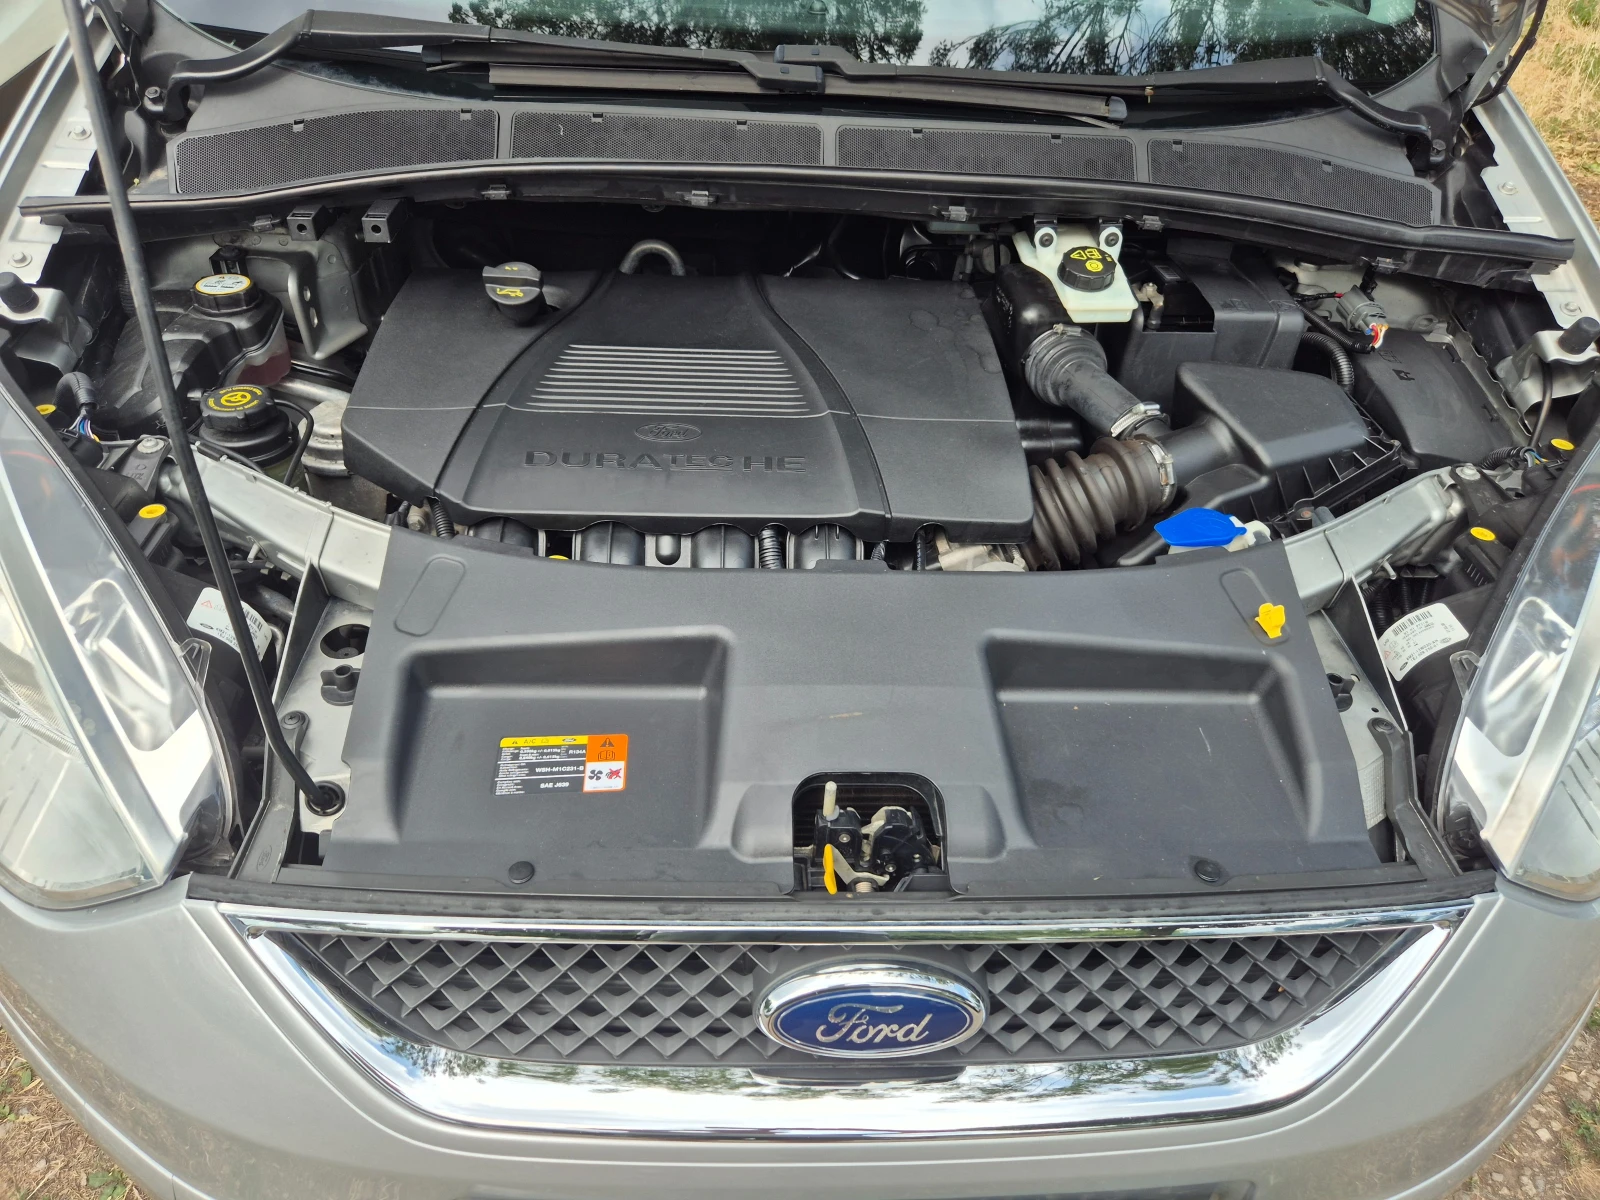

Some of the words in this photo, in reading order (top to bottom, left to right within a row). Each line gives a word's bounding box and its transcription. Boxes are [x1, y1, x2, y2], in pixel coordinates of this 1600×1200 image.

[648, 423, 690, 440] Ford
[523, 450, 734, 471] DURATEC
[743, 455, 806, 473] HE
[815, 1003, 933, 1044] Ford
